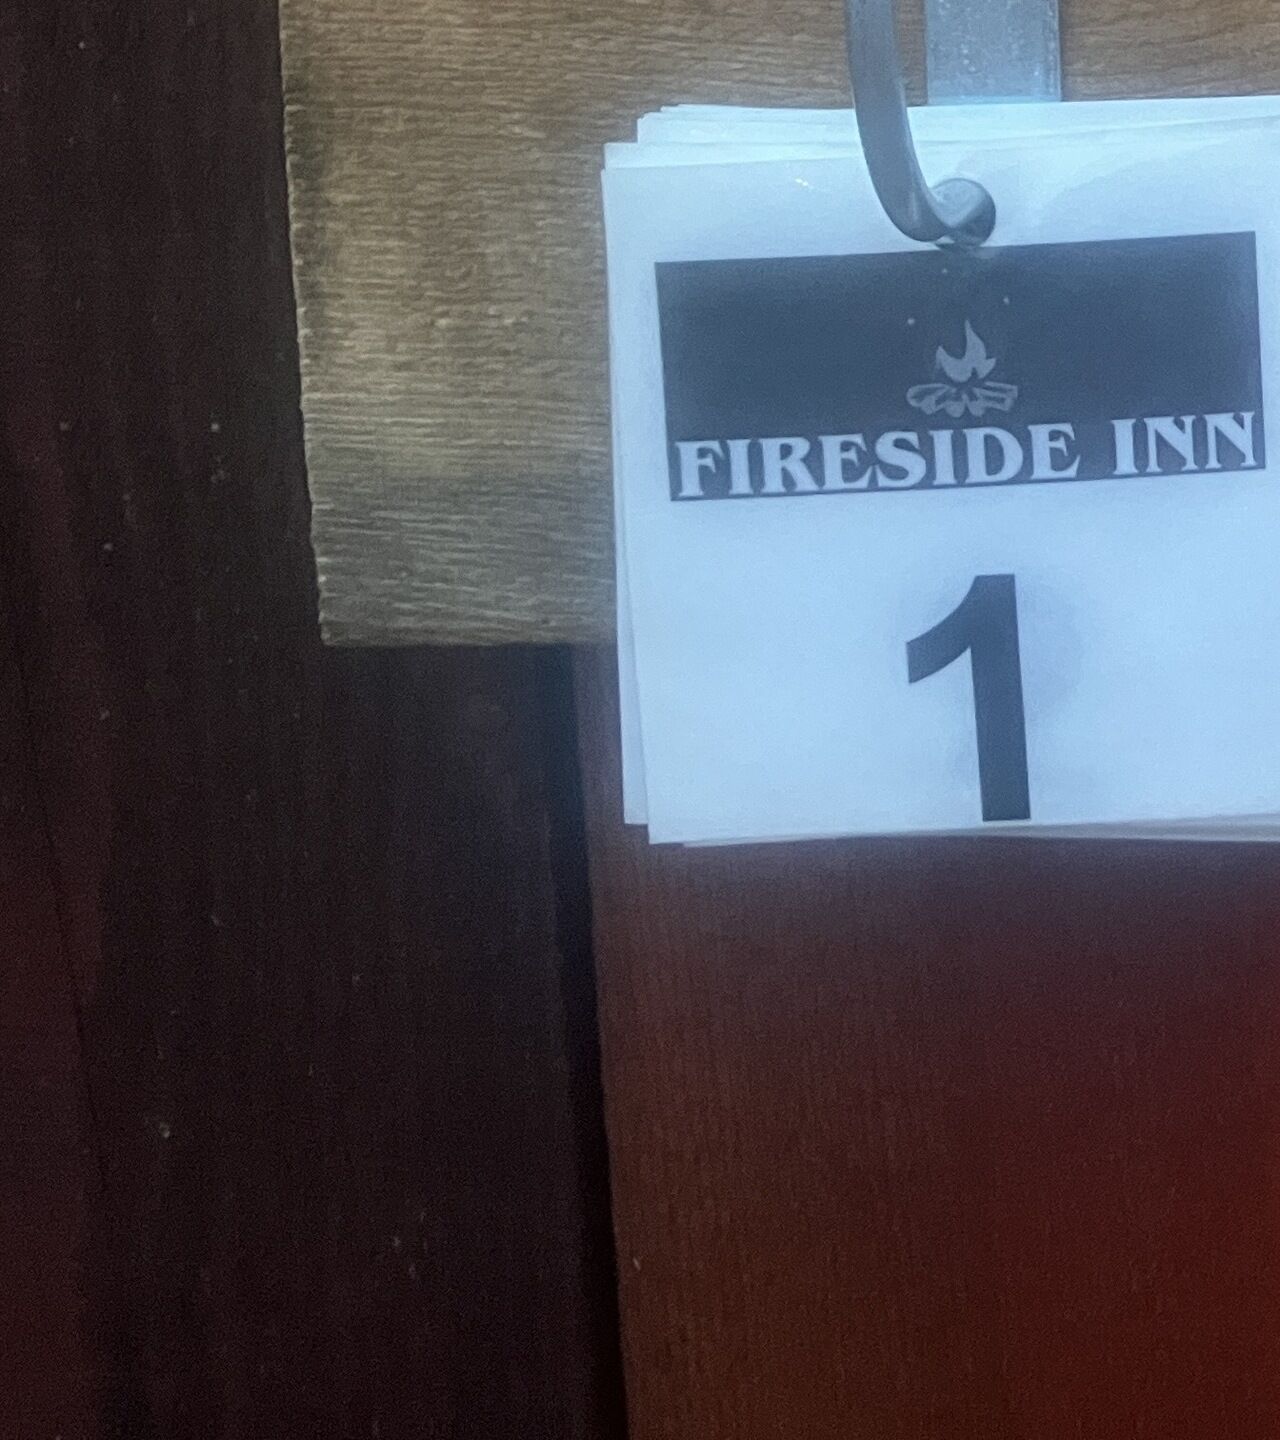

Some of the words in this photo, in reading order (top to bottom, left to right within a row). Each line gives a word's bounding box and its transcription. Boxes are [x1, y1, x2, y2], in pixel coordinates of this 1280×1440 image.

[675, 423, 1080, 498] FIRESIDE
[1111, 412, 1258, 475] INN
[906, 574, 1031, 822] 1
